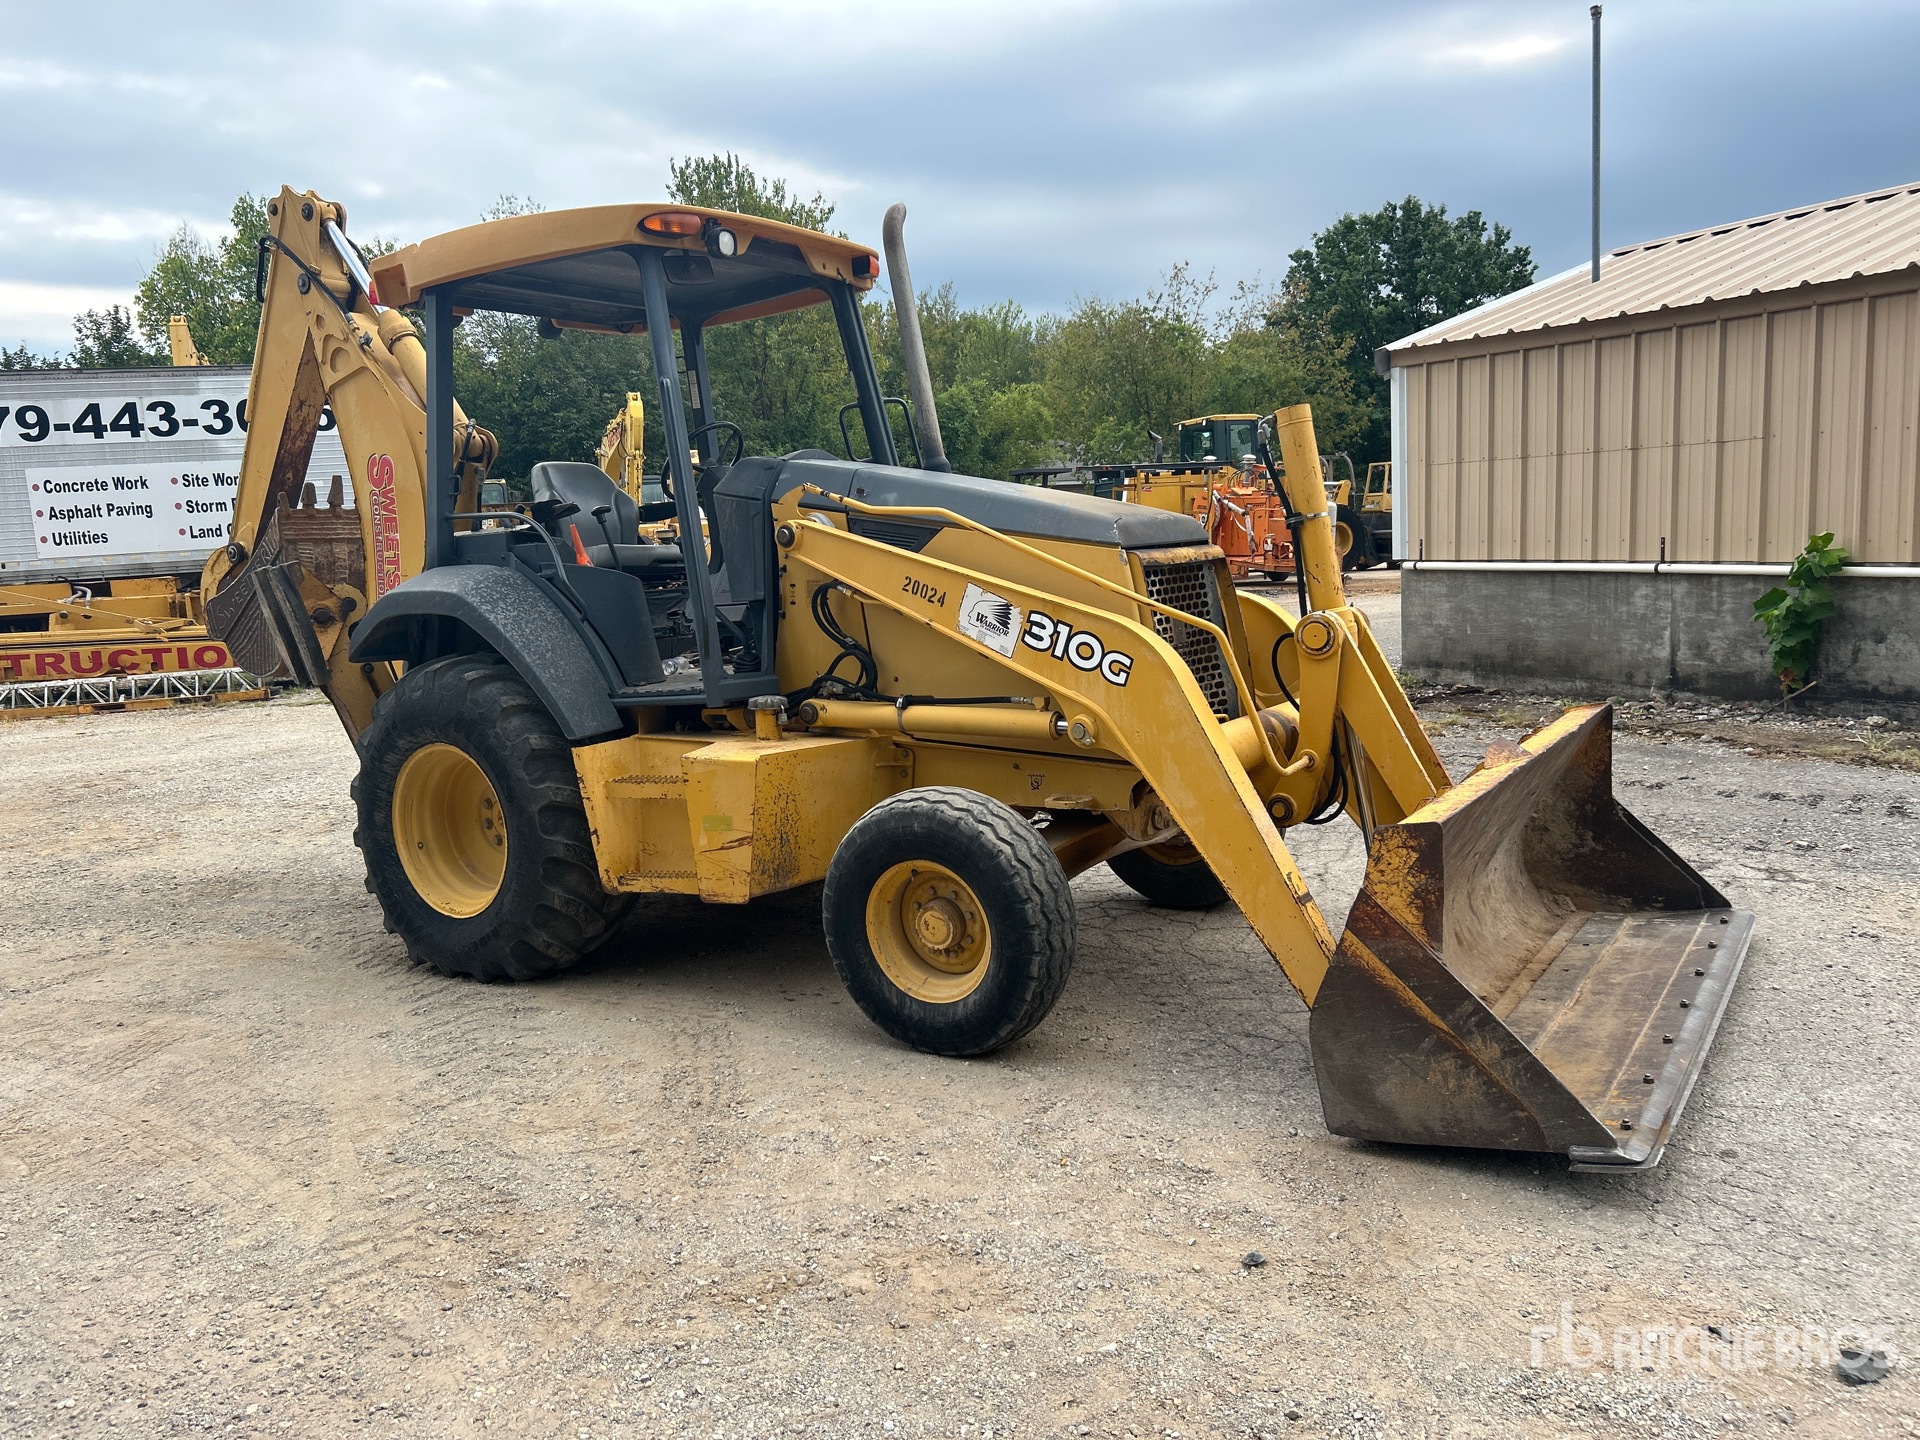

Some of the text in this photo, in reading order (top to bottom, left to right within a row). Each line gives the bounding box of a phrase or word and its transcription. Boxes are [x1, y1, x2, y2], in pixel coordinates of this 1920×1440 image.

[43, 475, 149, 494] Concrete Work
[182, 472, 240, 487] Site Wor
[49, 502, 153, 523] Asphalt Paving
[185, 499, 227, 513] Storm
[52, 530, 109, 546] Utilities
[189, 523, 223, 539] Land
[372, 493, 385, 598] CONSTRUCTIO
[901, 575, 946, 608] 20024
[1021, 609, 1134, 687] 310G
[0, 645, 238, 677] TRUCTIO
